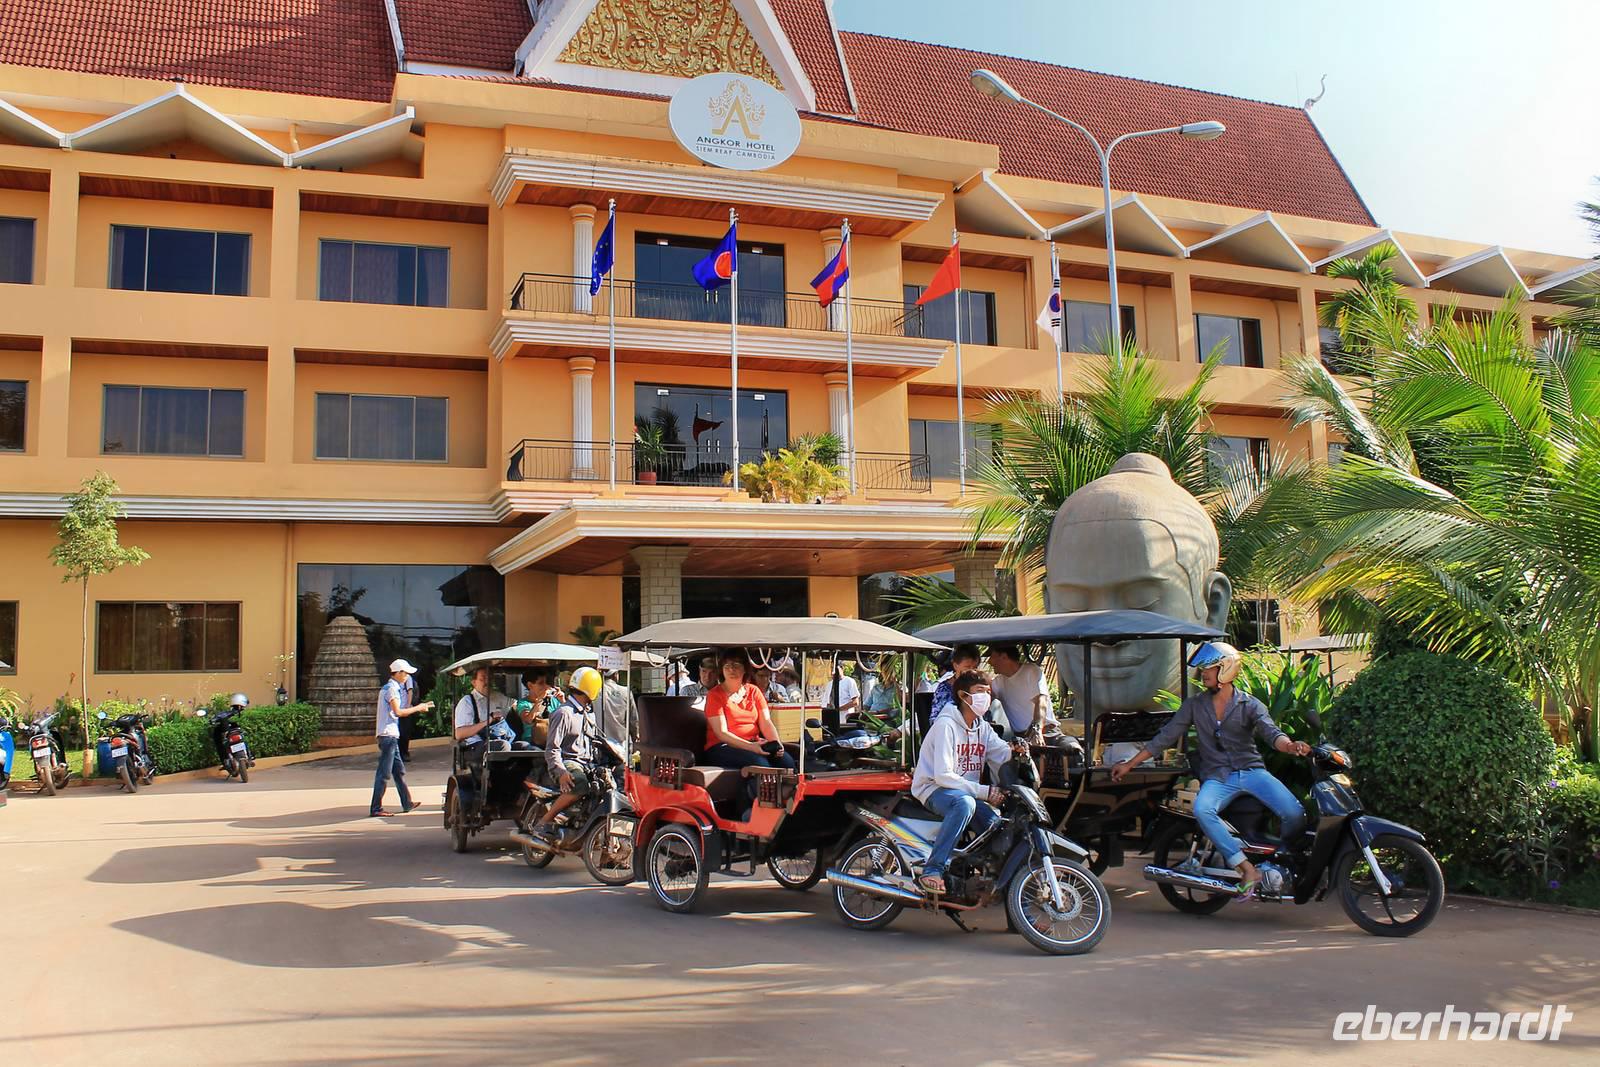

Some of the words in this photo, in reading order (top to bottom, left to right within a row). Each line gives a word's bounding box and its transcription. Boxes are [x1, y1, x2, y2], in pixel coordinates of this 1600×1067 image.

[696, 136, 741, 148] ANGKOR
[746, 142, 776, 152] HOTEL
[736, 150, 776, 161] CAMBODIA
